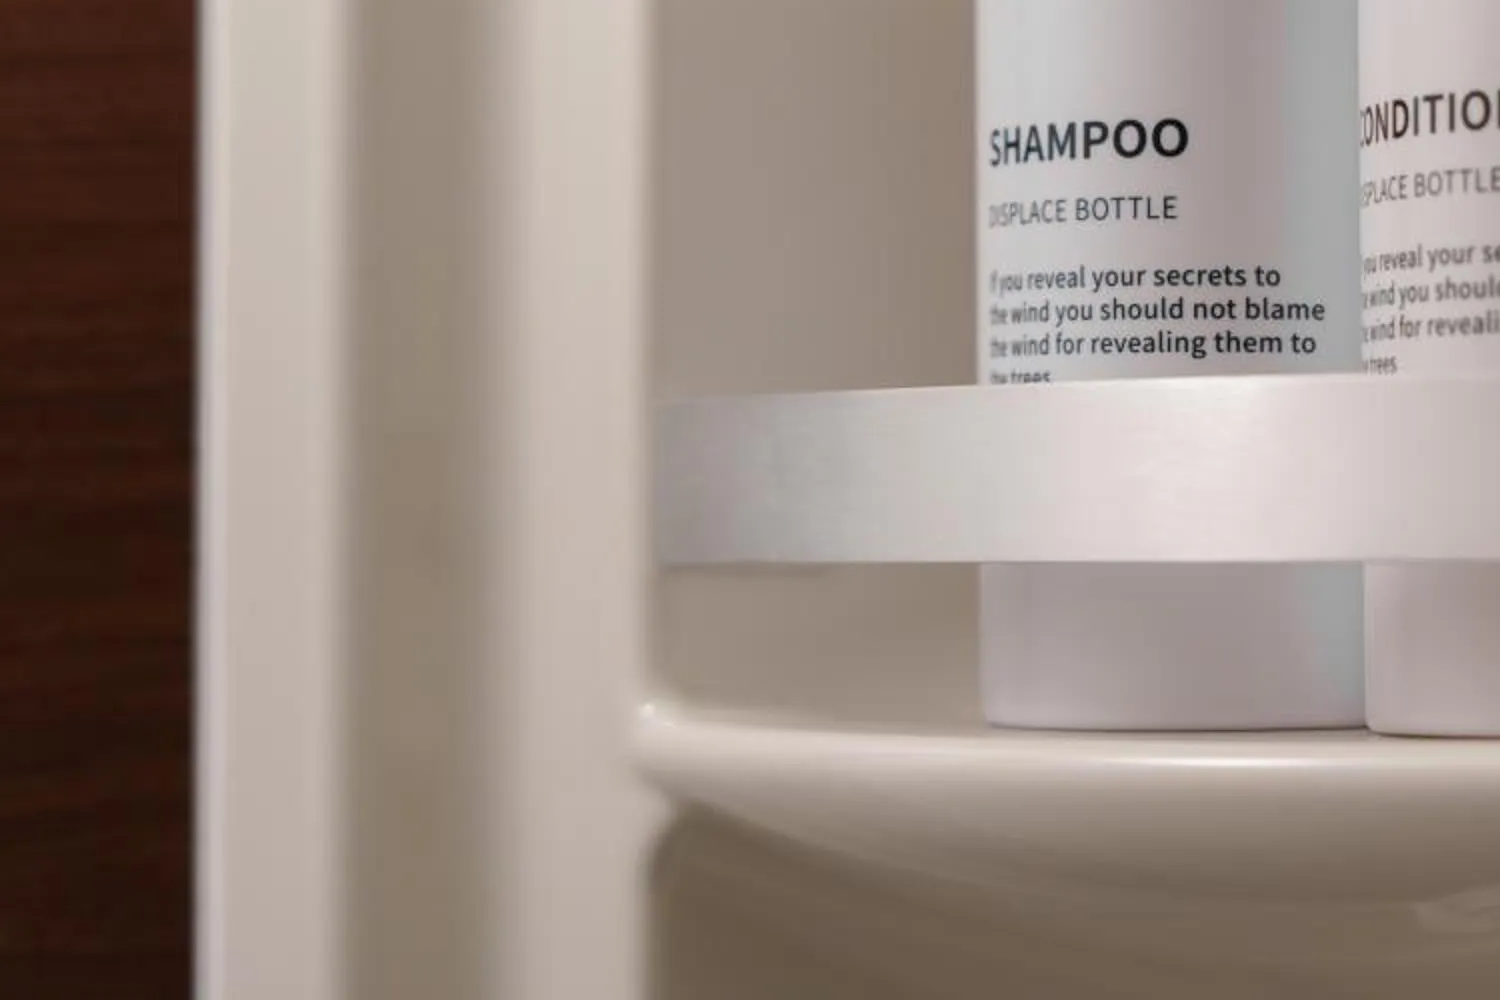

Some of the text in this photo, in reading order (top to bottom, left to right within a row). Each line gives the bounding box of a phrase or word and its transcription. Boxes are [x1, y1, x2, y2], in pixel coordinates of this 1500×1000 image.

[990, 118, 1189, 167] SHAMPOO
[1075, 196, 1177, 221] BOTTLE
[1380, 244, 1422, 271] reveal
[1427, 246, 1475, 273] your
[1027, 264, 1086, 289] reveal
[1092, 268, 1147, 293] your
[1153, 265, 1247, 288] secrets
[1255, 266, 1281, 288] to
[1011, 300, 1050, 324] wind
[1055, 304, 1093, 328] you
[1100, 296, 1184, 321] should
[1193, 299, 1237, 321] not
[1245, 297, 1326, 321] blame
[1399, 285, 1429, 310] you
[1400, 314, 1421, 338] for
[1011, 333, 1050, 356] wind
[1056, 331, 1085, 355] for
[1090, 330, 1207, 359] revealing
[1214, 330, 1283, 354] them
[1291, 332, 1317, 353] to
